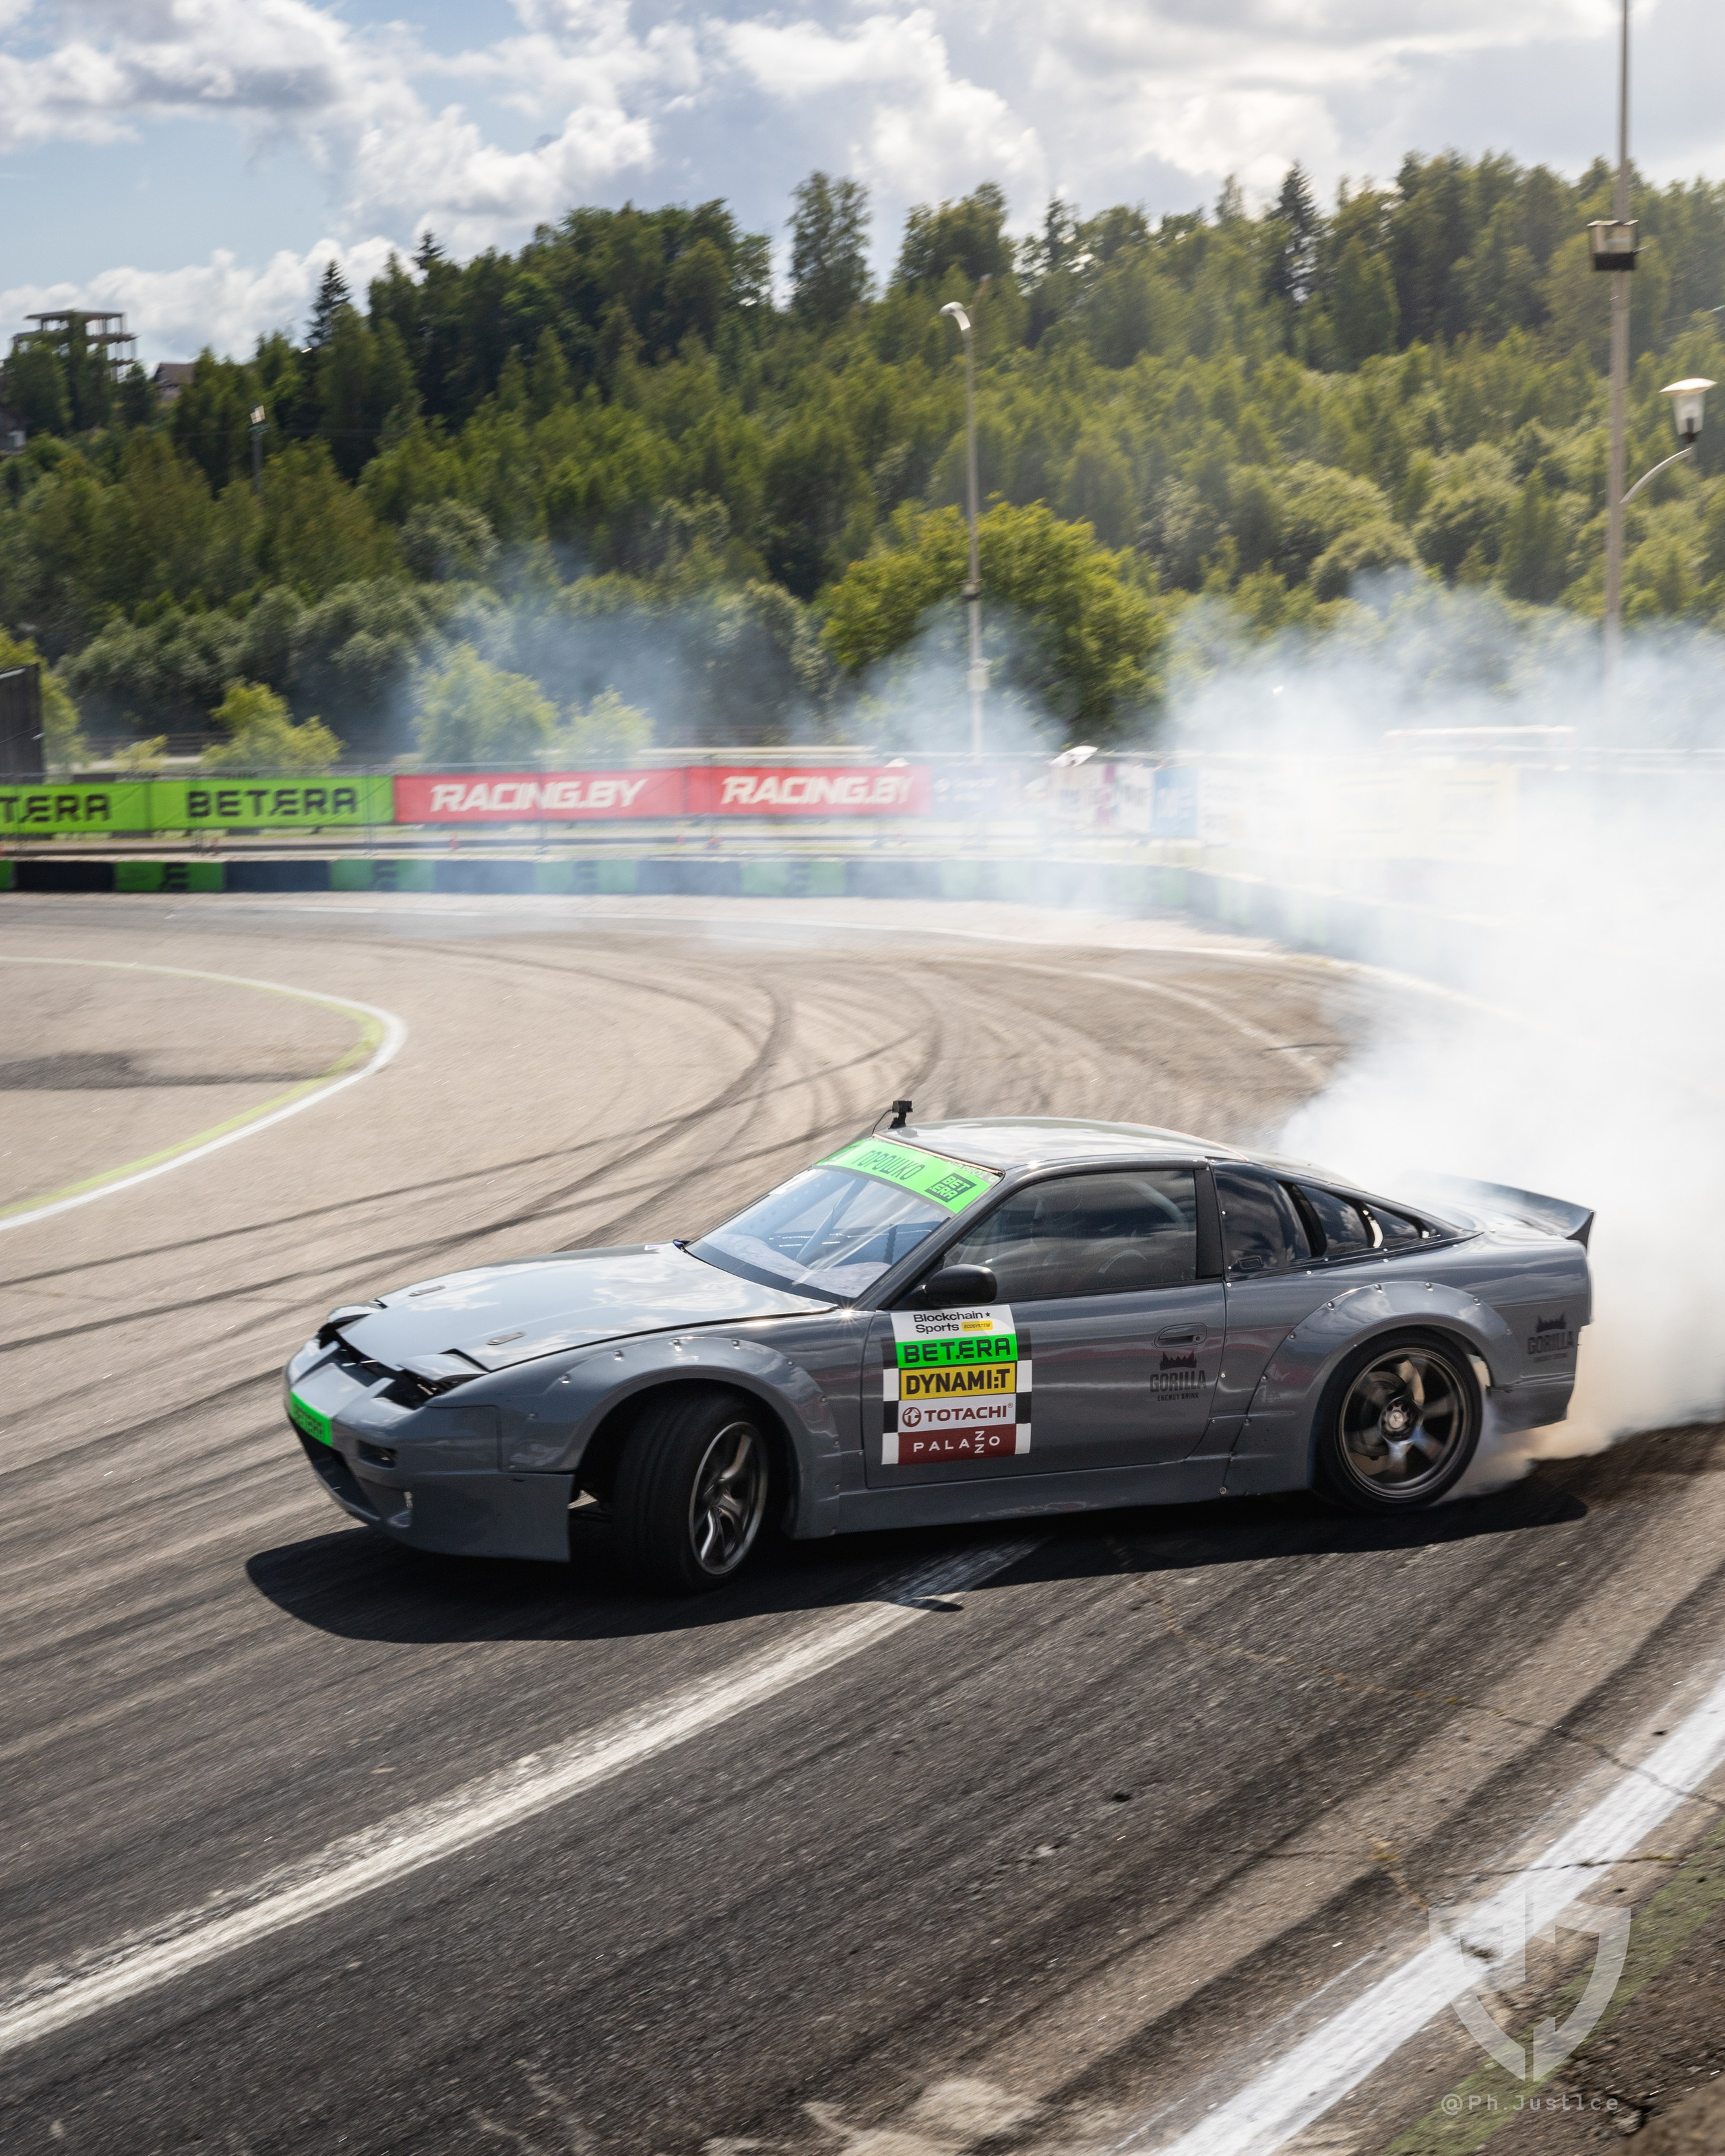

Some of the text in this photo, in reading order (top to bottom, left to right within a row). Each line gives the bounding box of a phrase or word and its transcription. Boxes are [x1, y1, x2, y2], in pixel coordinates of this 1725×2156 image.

[430, 778, 649, 812] RACING.BY
[720, 775, 914, 805] RACING.BY
[851, 1150, 925, 1180] ГОРОШКО
[914, 1310, 982, 1323] Blockchain
[916, 1323, 960, 1334] Sports
[1150, 1370, 1207, 1393] GORILLA
[1157, 1393, 1180, 1401] ENERGY
[924, 1405, 1007, 1422] TOTACHI
